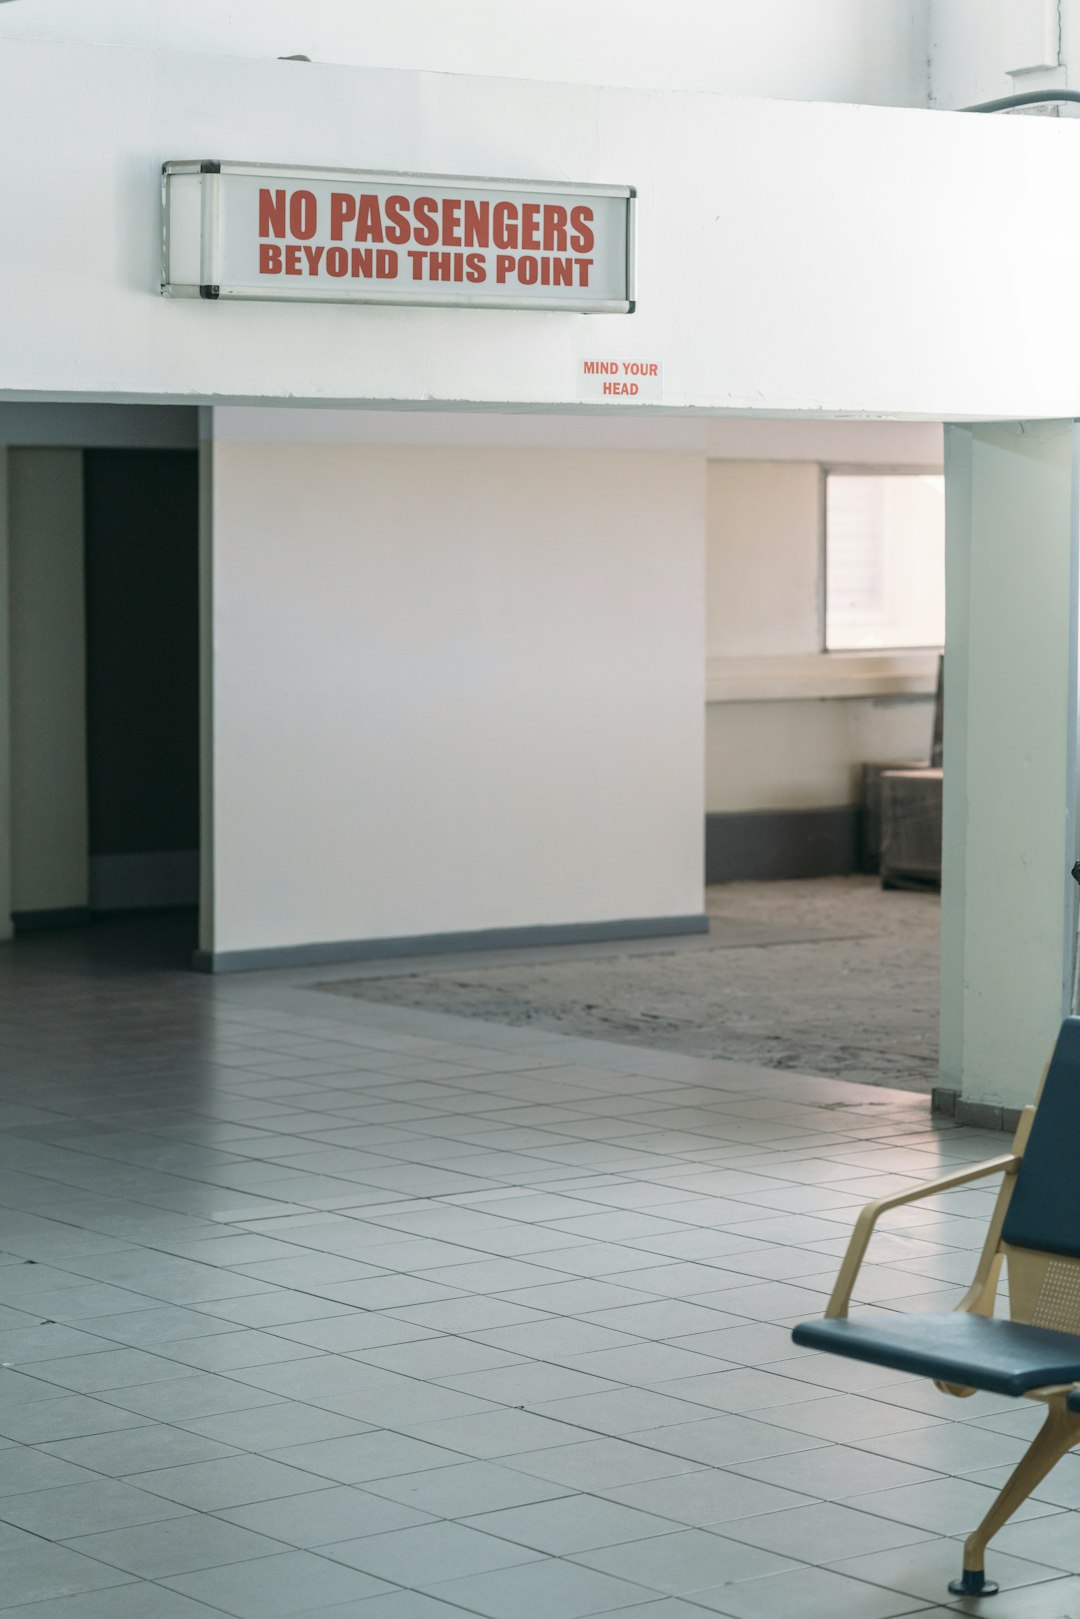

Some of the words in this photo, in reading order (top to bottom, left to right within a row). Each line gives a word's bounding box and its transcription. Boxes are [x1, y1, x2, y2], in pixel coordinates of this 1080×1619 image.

[259, 189, 317, 240] NO
[331, 192, 594, 253] PASSENGERS
[259, 244, 398, 279] BEYOND
[408, 251, 486, 283] THIS
[496, 255, 593, 287] POINT
[583, 361, 619, 375] MIND
[622, 362, 658, 376] YOUR
[603, 382, 639, 396] HEAD
